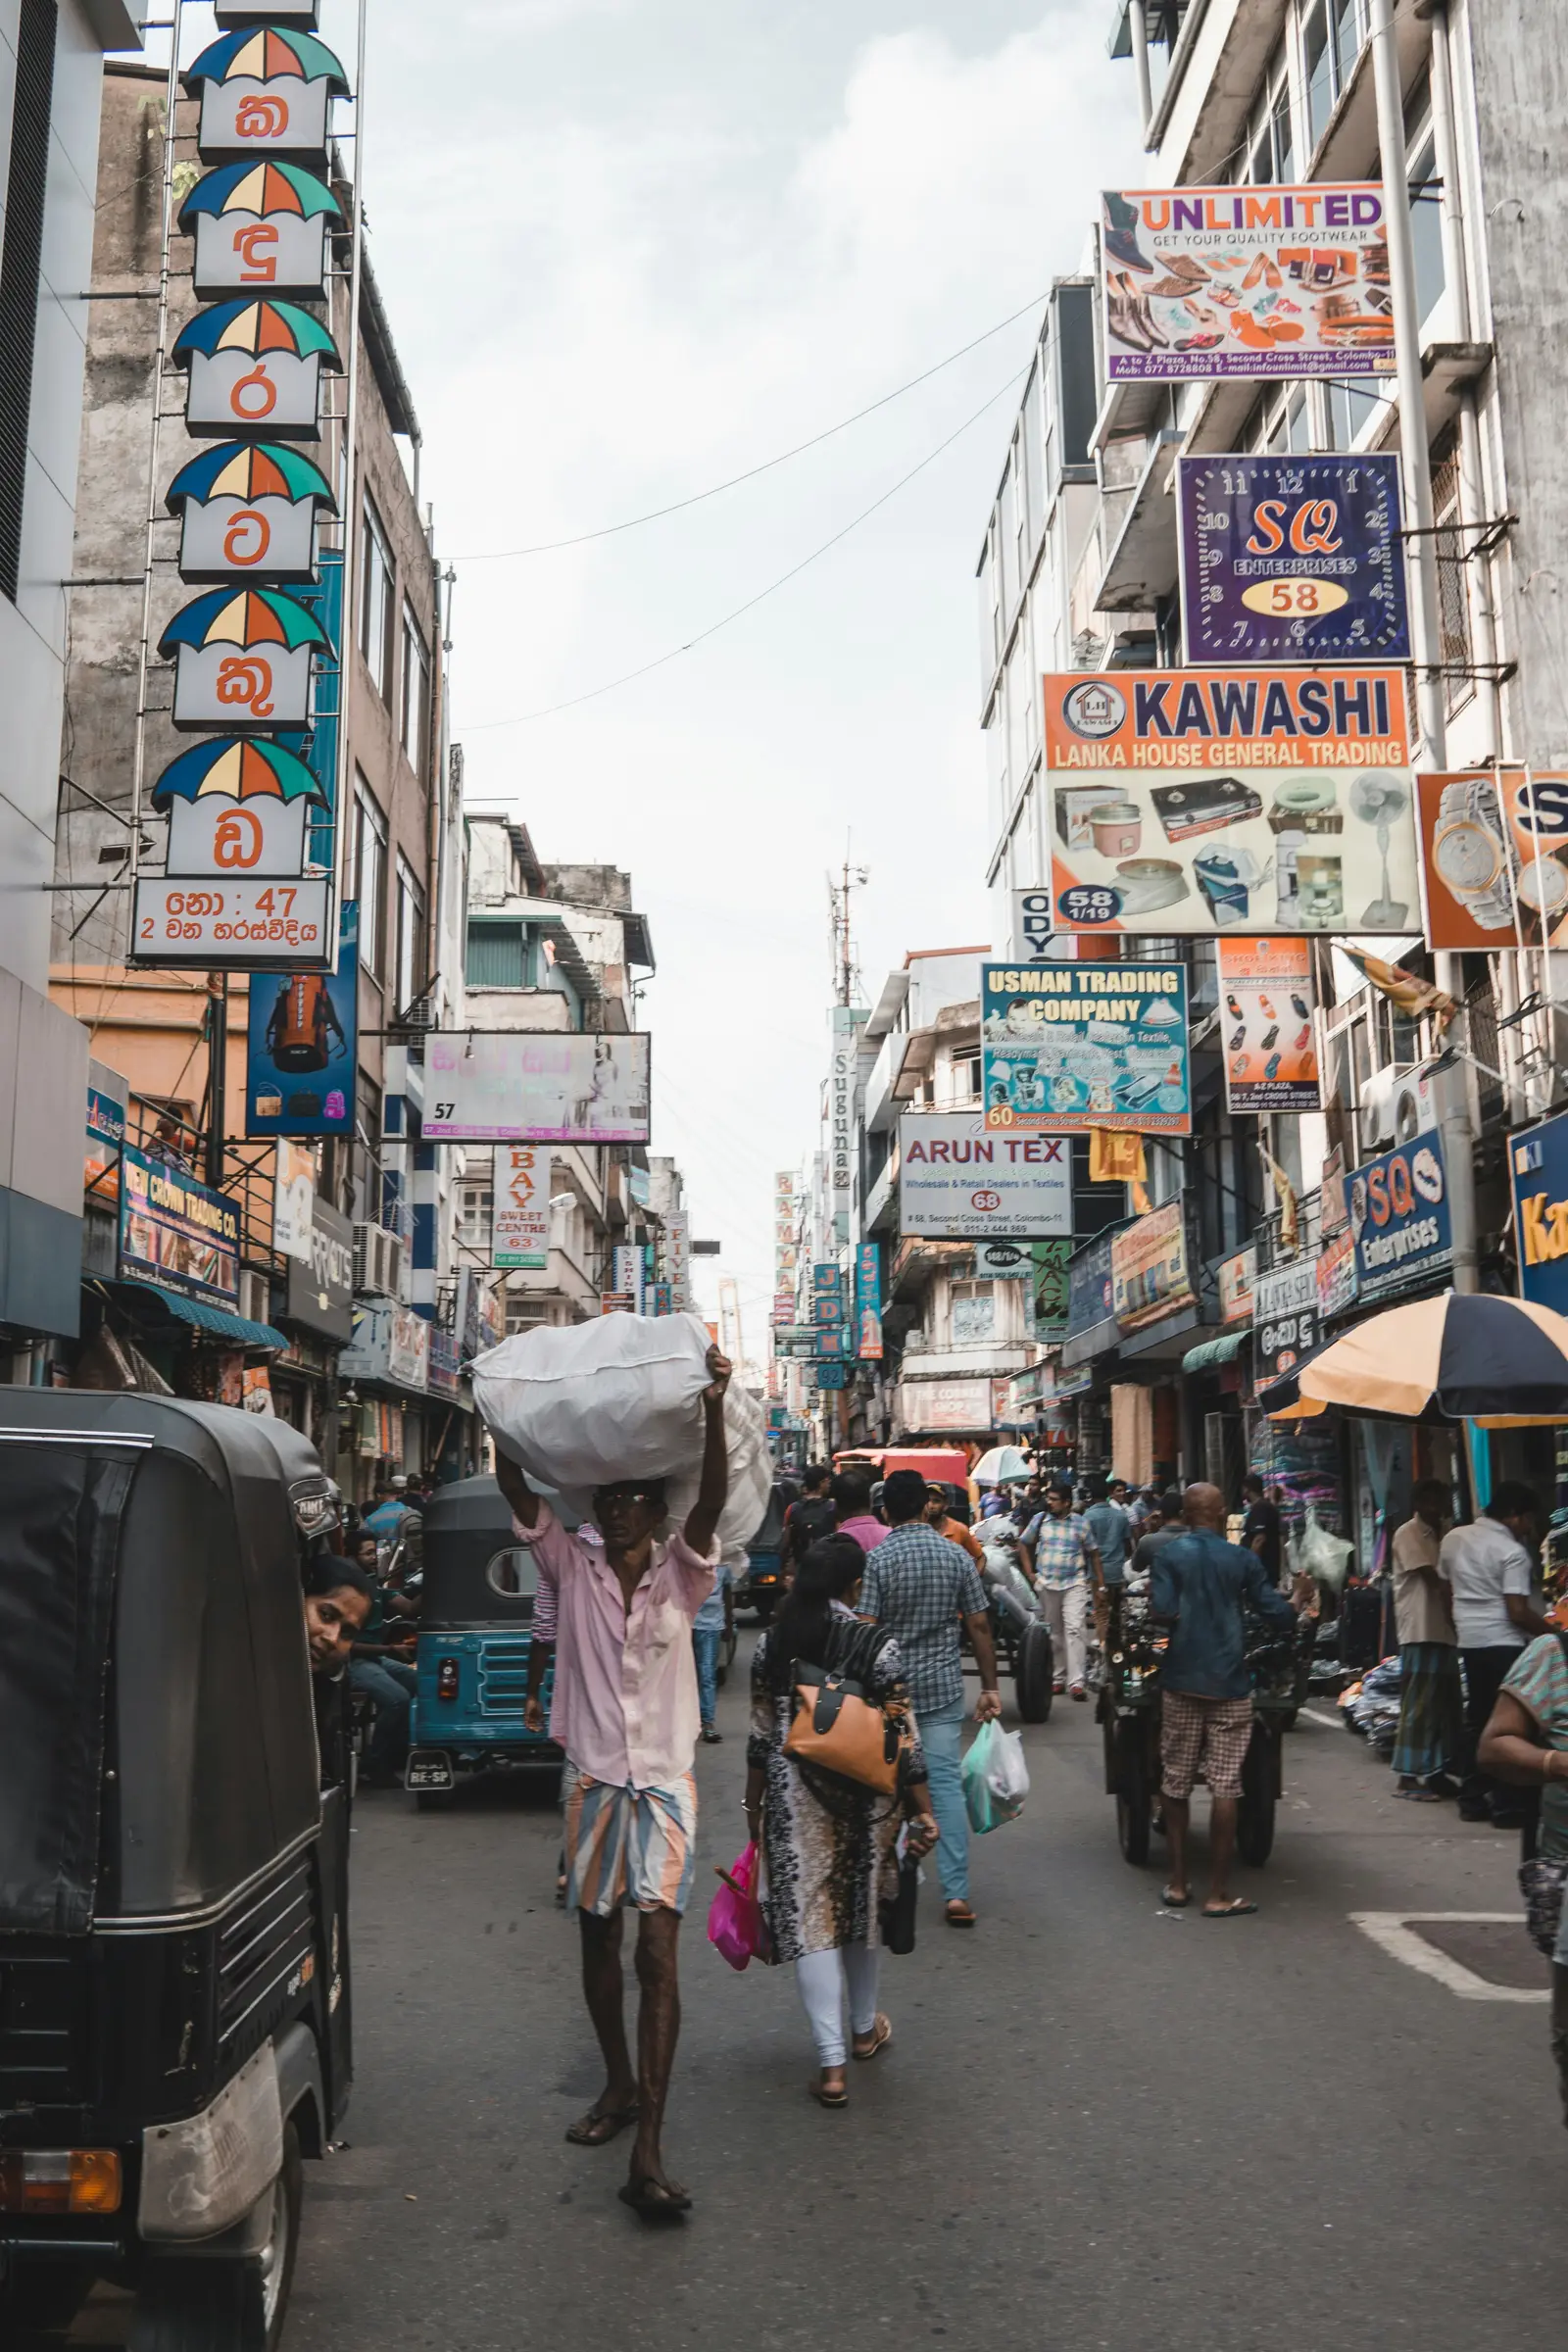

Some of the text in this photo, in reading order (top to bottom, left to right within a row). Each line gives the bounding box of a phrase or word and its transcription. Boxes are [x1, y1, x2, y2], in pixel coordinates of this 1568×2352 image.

[1142, 194, 1382, 231] UNLIMITED
[1152, 230, 1368, 247] GET YOUR QUALITY FOOTWEAR
[1119, 356, 1128, 366] A
[1132, 356, 1142, 366] to
[1146, 355, 1152, 365] Z
[1156, 355, 1187, 366] Plaza,
[1227, 353, 1262, 364] Second
[1266, 353, 1295, 363] Cross
[1298, 352, 1333, 363] Street,
[1115, 366, 1141, 374] Mob:
[1145, 365, 1164, 373] 077
[1223, 475, 1358, 495] 11 12 1
[1206, 512, 1229, 530] 10
[1246, 498, 1343, 556] SQ
[1365, 510, 1381, 528] 2
[1207, 549, 1223, 567] 9
[1368, 547, 1382, 565] 3
[1233, 557, 1358, 576] ENTERPRISES
[1209, 584, 1224, 604] 8
[1271, 583, 1319, 612] 58
[1369, 582, 1385, 601] 4
[1233, 620, 1249, 639] 7
[1290, 619, 1305, 638] 6
[1350, 618, 1366, 638] 5
[1085, 701, 1106, 711] LH
[1132, 677, 1392, 739] KAWASHI
[1054, 740, 1403, 768] LANKA HOUSE GENERAL TRADING
[255, 887, 298, 917] 47
[1067, 890, 1113, 906] 58
[1068, 907, 1110, 919] 1/19
[140, 917, 155, 939] 2
[988, 969, 1178, 994] USMAN TRADING
[1028, 999, 1142, 1022] COMPANY
[1137, 1031, 1172, 1045] Textile,
[433, 1102, 457, 1120] 57
[834, 1054, 849, 1167] Suguna
[988, 1106, 1013, 1126] 60
[906, 1140, 1063, 1163] ARUN TEX
[906, 1179, 1065, 1189] Wholesale & Retail Dealers in Textiles
[1367, 1153, 1417, 1227] SQ
[150, 1175, 185, 1215] CROWN
[185, 1192, 223, 1234] TRADING
[223, 1211, 238, 1241] CO.
[973, 1194, 999, 1209] 68
[500, 1210, 543, 1221] SWEET
[928, 1214, 959, 1223] Second
[960, 1214, 984, 1223] Cross
[986, 1214, 1012, 1224] Street,
[496, 1222, 547, 1234] CENTRE
[509, 1237, 532, 1248] 63
[1360, 1215, 1440, 1271] Enterprises
[410, 1771, 449, 1784] RE-SP
